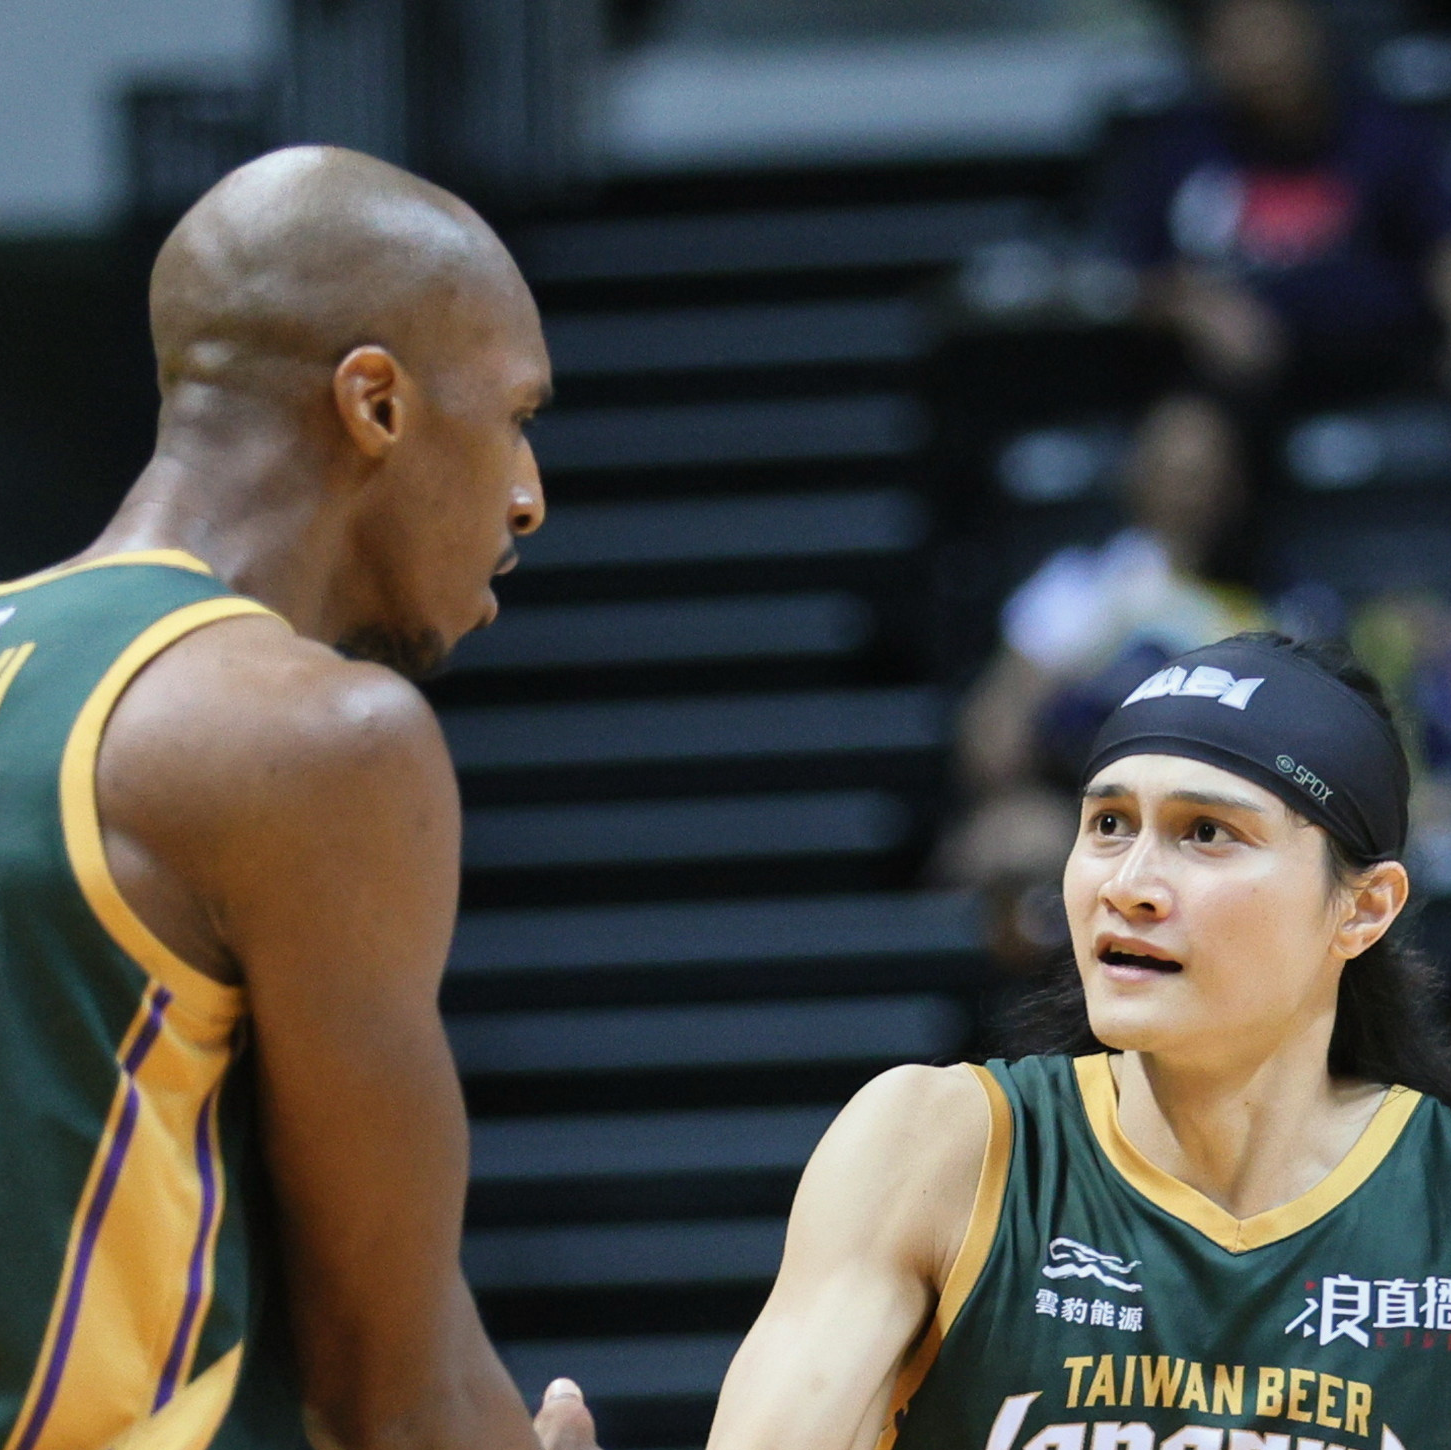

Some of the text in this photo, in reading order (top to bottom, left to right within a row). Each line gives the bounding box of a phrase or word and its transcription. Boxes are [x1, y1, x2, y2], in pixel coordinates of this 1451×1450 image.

[1035, 1288, 1143, 1332] 雲豹能源
[1063, 1354, 1372, 1437] TAIWAN BEER
